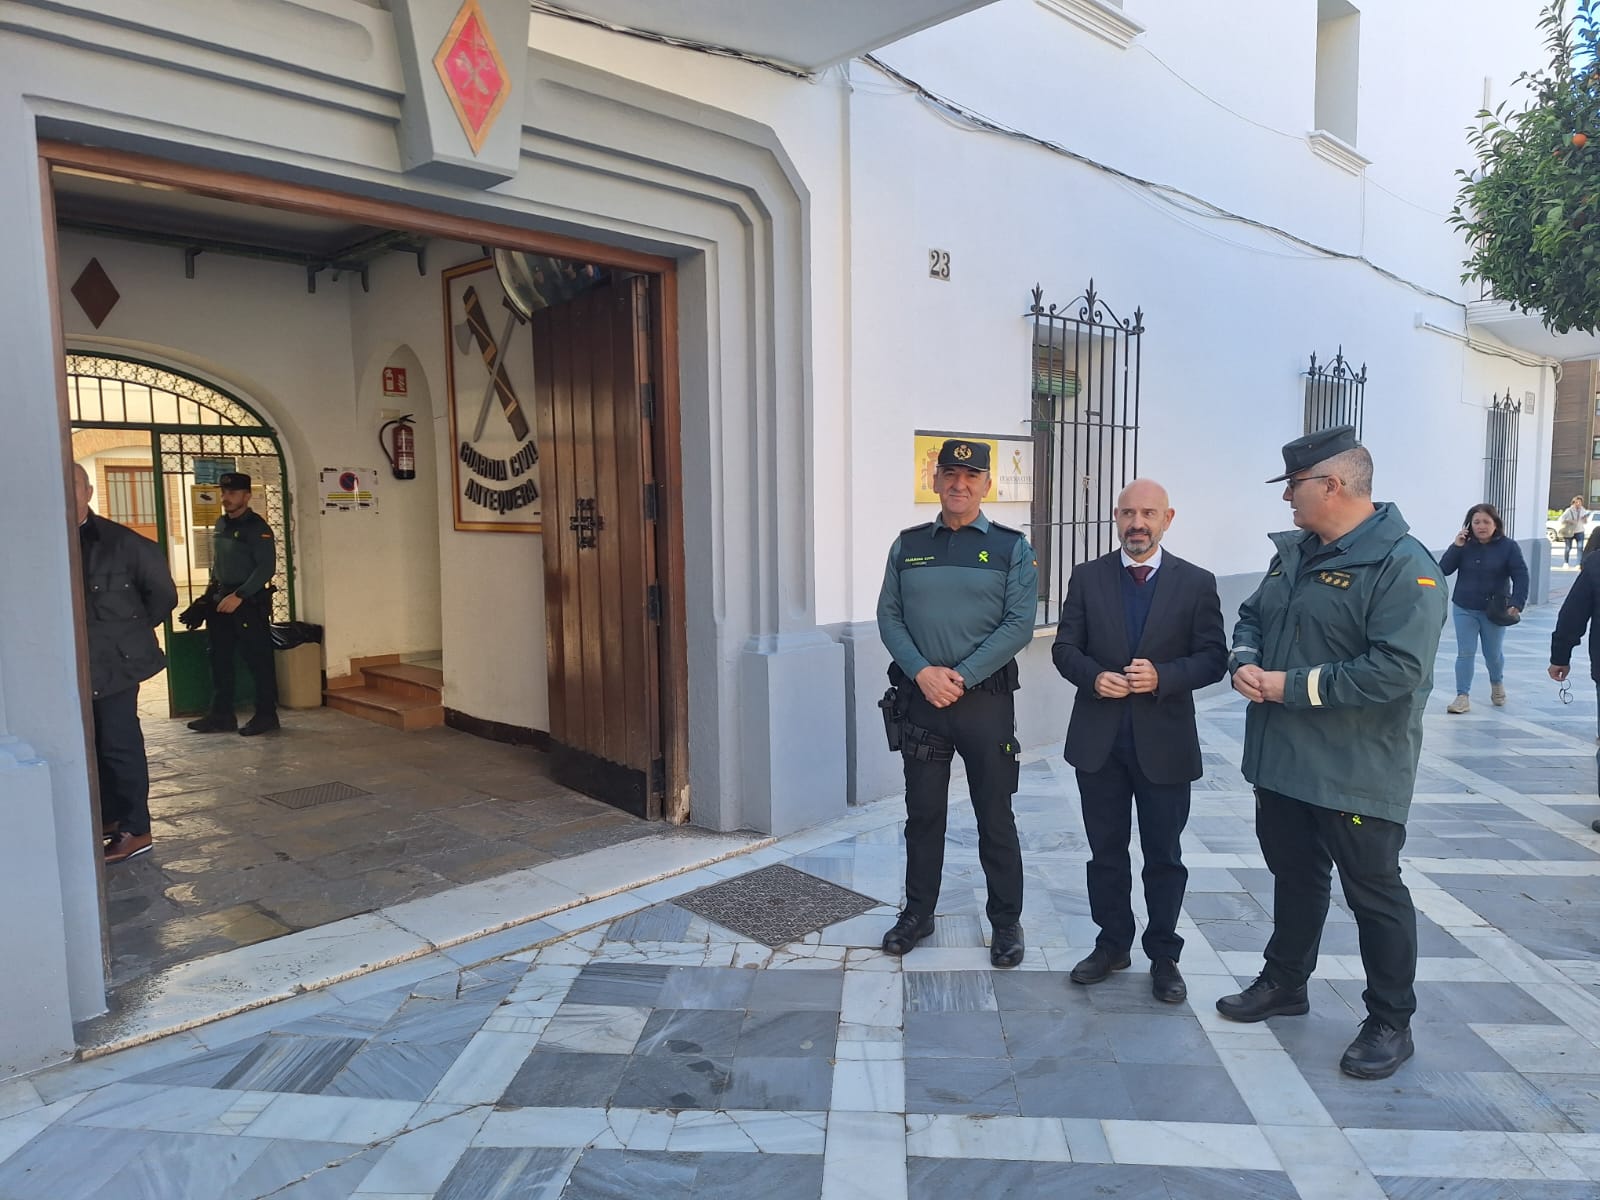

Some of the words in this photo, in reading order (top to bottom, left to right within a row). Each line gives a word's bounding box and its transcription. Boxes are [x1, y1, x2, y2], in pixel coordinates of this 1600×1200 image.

[930, 250, 950, 278] 23
[460, 441, 507, 481] GUARDIA
[510, 440, 539, 477] CIVIL
[464, 478, 539, 515] ANTEQUERA
